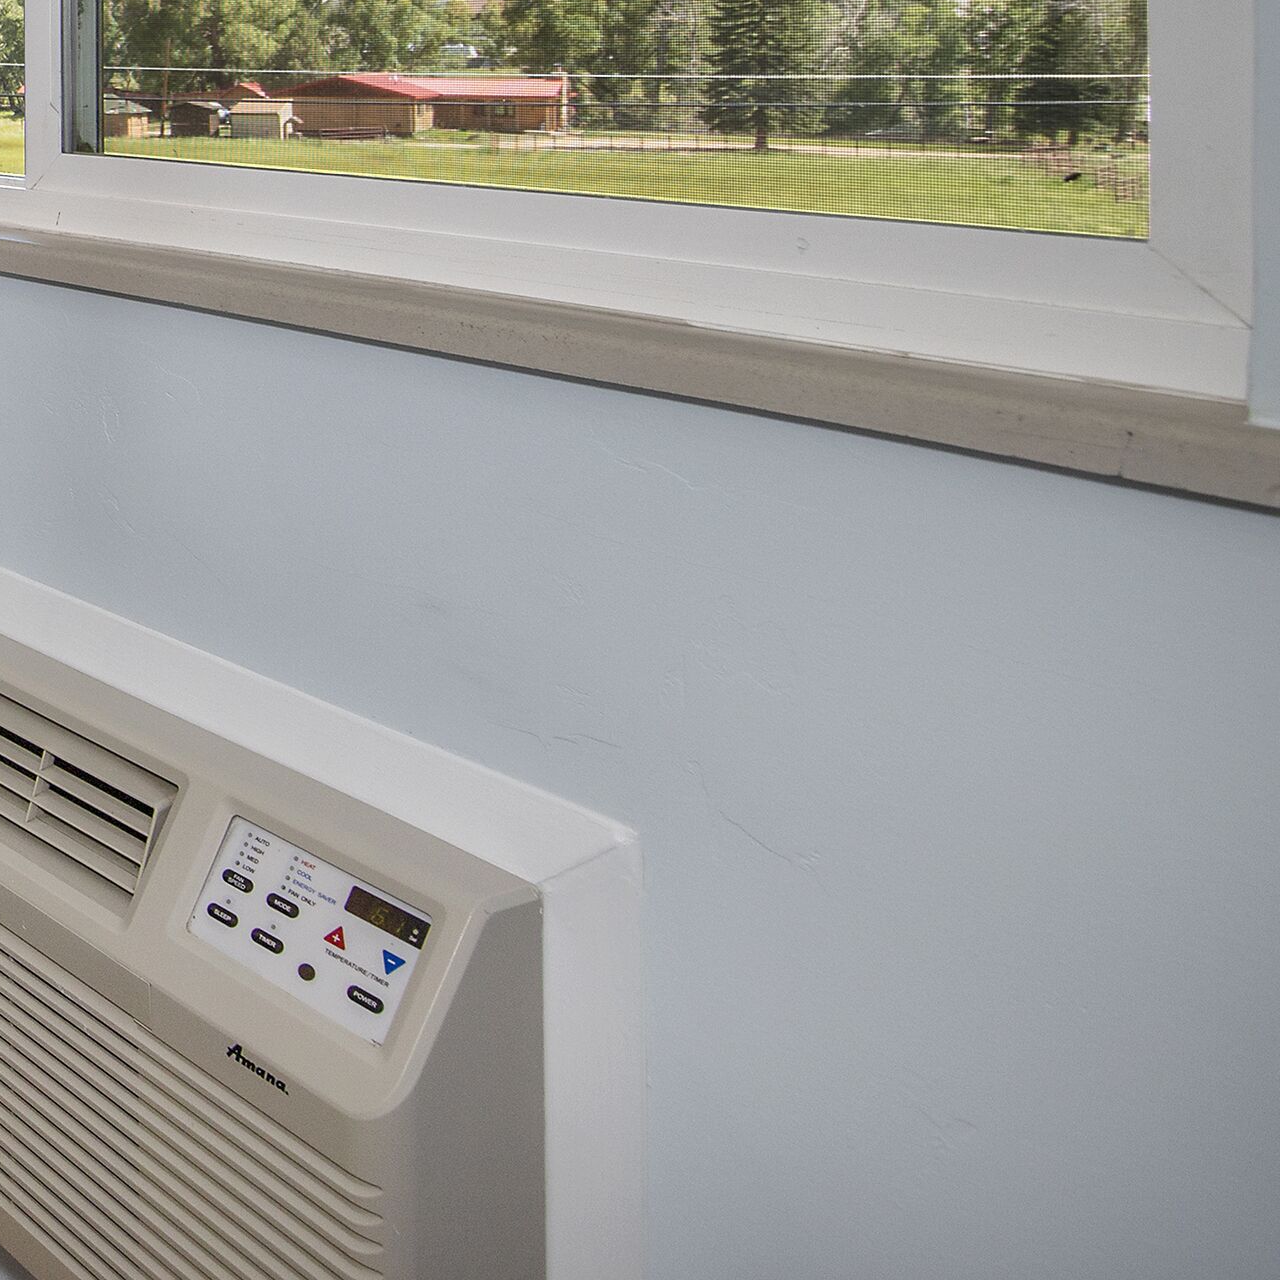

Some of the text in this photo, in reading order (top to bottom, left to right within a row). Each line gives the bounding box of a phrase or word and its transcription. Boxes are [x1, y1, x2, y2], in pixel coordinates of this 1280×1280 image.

[254, 836, 271, 847] AUTO
[251, 846, 265, 855] HIGH
[246, 854, 260, 864] MED
[301, 859, 316, 870] HEAT
[242, 864, 255, 874] LOW
[296, 869, 313, 881] COOL
[292, 879, 316, 894] ENERGY
[288, 888, 317, 907] FAN ONLY
[274, 899, 292, 913] MODE
[258, 933, 277, 948] TIMER
[325, 948, 390, 988] TEMPERATURE/TIMER
[353, 990, 378, 1008] POWER
